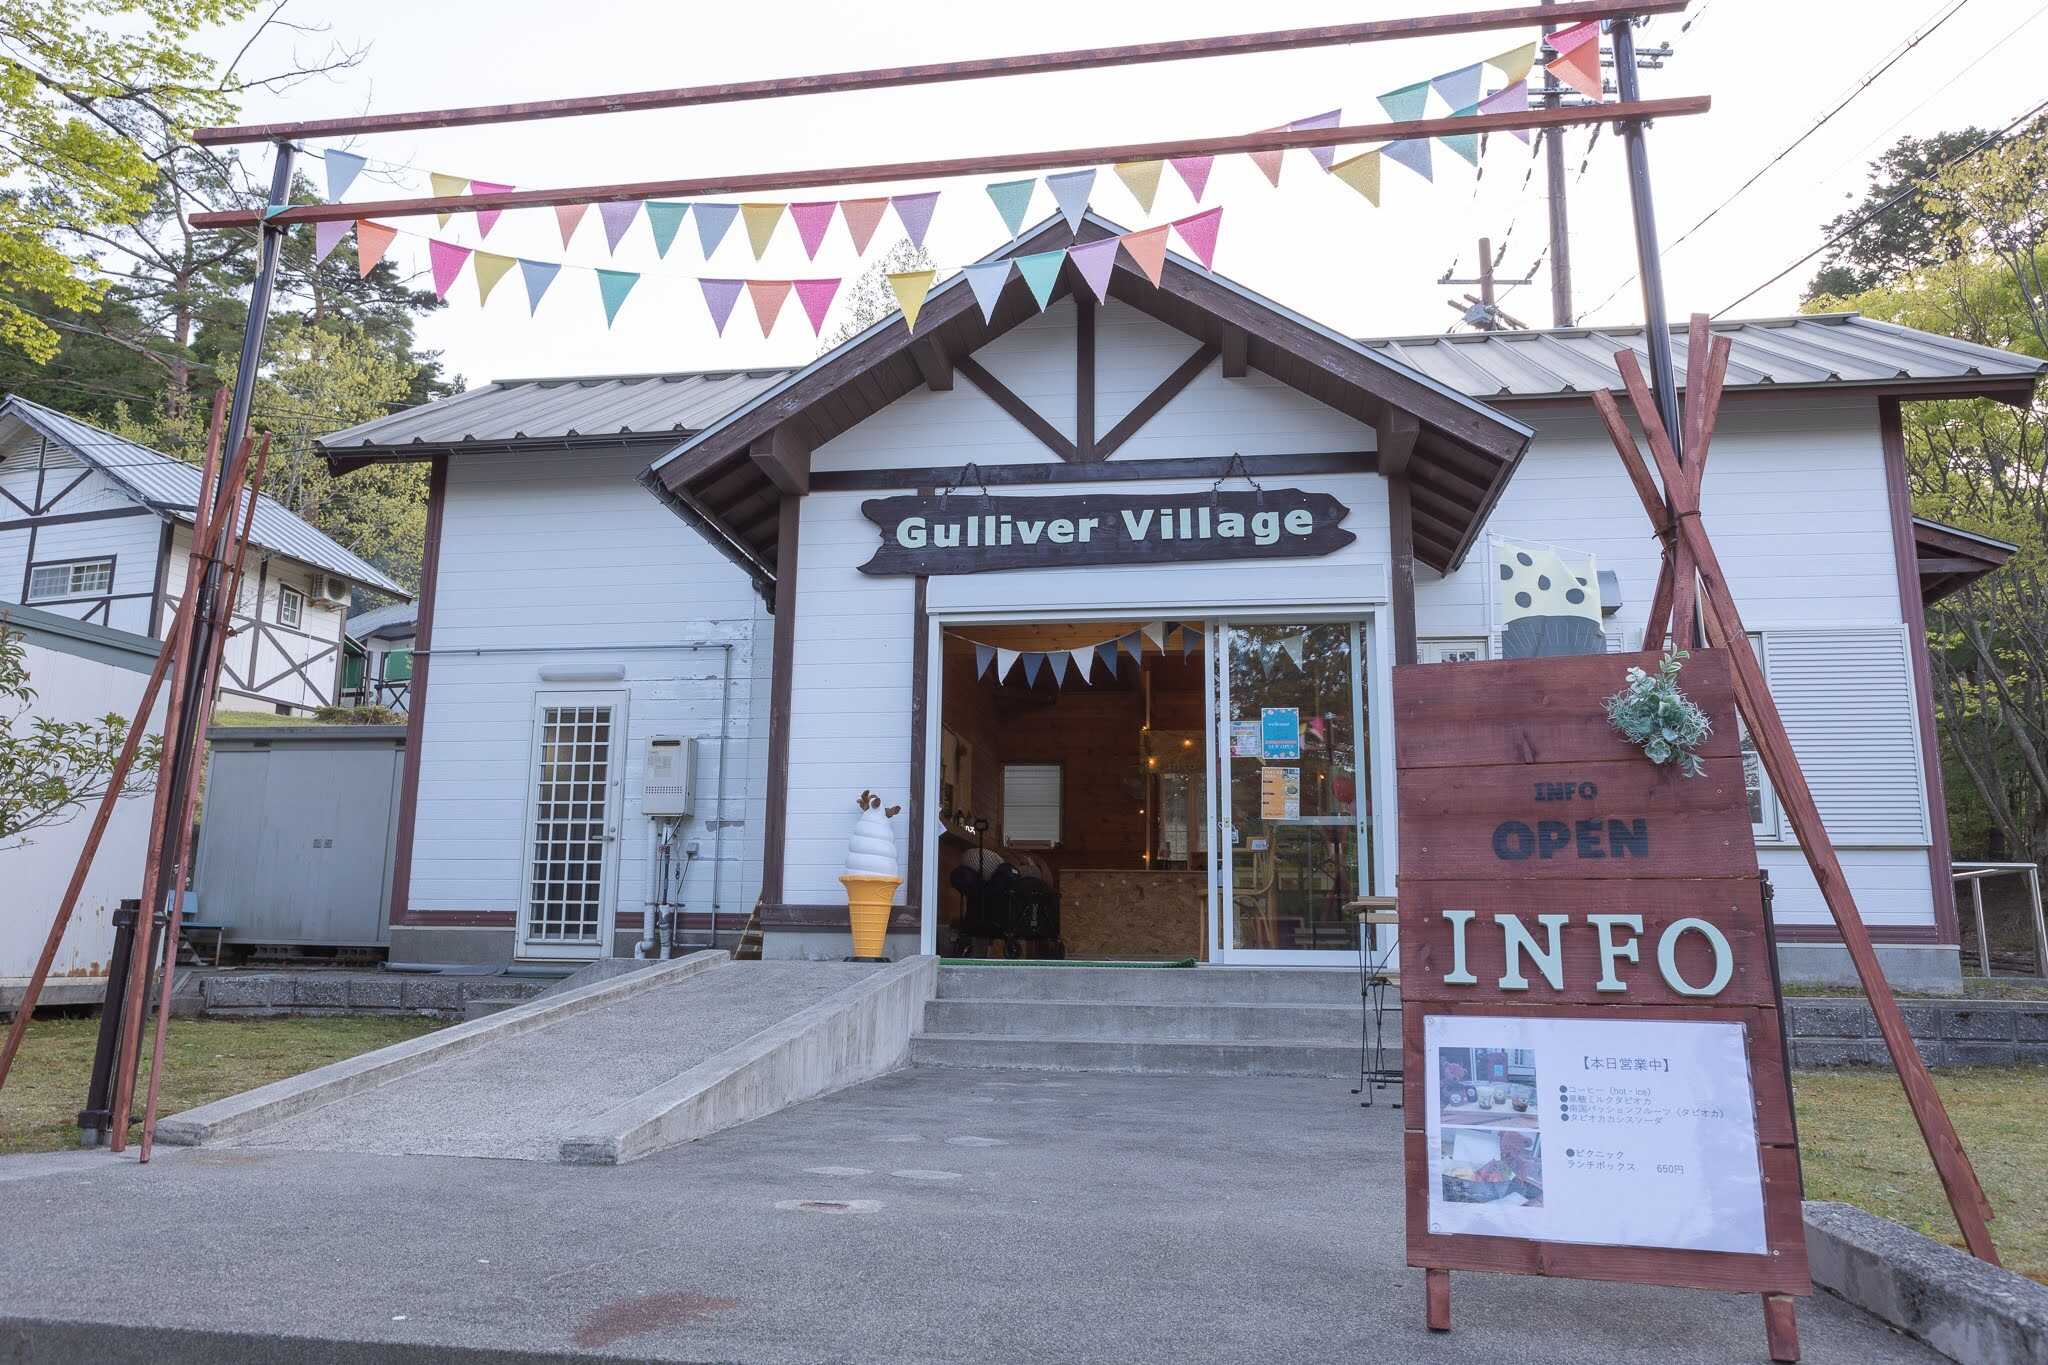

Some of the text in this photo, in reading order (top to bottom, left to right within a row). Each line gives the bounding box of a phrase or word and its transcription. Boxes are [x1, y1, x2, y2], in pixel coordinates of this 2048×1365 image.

[896, 506, 1314, 549] Gulliver Village
[1534, 782, 1598, 801] INFO
[1492, 816, 1649, 860] OPEN
[1442, 909, 1735, 998] INFO
